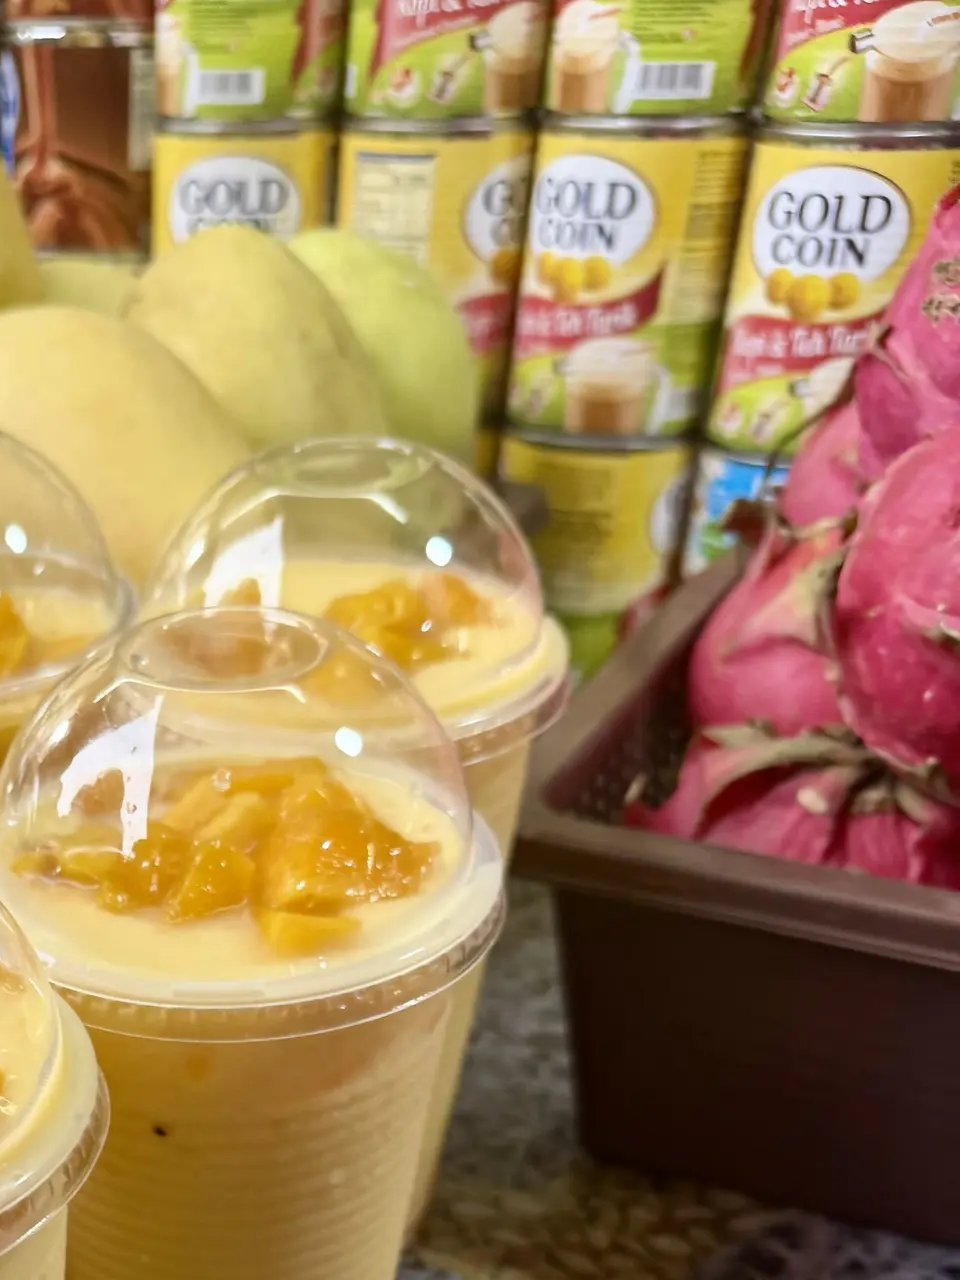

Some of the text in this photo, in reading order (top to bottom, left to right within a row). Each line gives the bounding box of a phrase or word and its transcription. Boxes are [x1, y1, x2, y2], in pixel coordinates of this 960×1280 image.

[180, 180, 288, 216] GOLD
[536, 179, 638, 221] GOLD
[768, 191, 893, 235] GOLD
[539, 218, 615, 251] COIN
[771, 234, 872, 269] COIN
